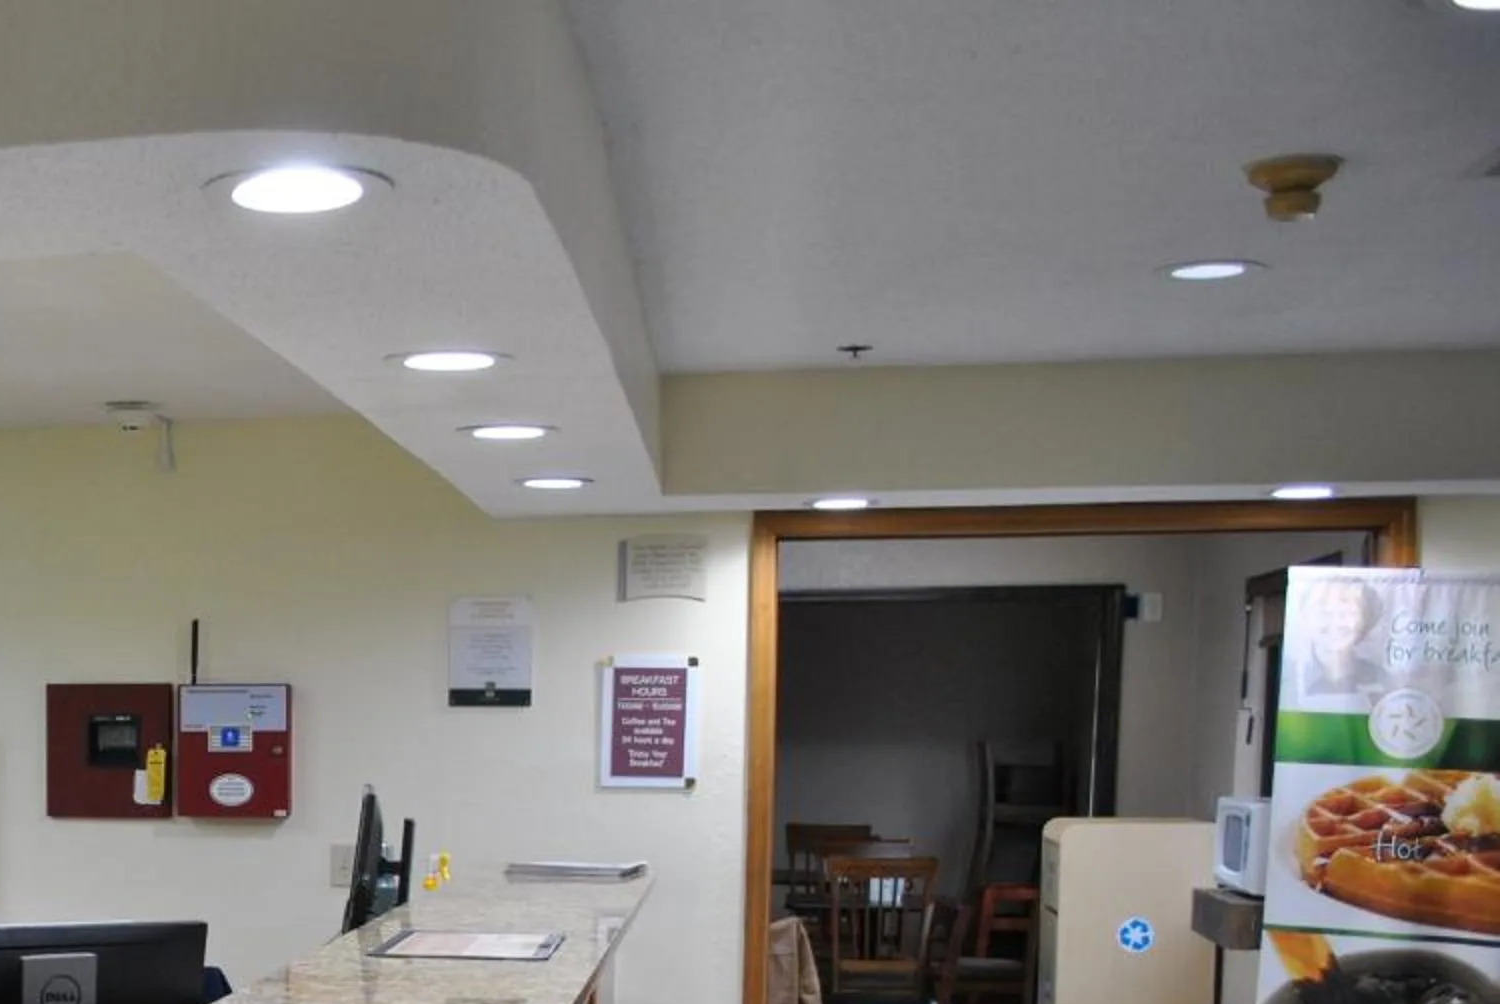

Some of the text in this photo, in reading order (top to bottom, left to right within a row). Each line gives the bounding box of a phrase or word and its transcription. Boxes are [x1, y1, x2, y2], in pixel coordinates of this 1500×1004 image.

[1391, 611, 1489, 645] Come join
[1386, 638, 1412, 667] for
[1373, 824, 1421, 861] Hot
